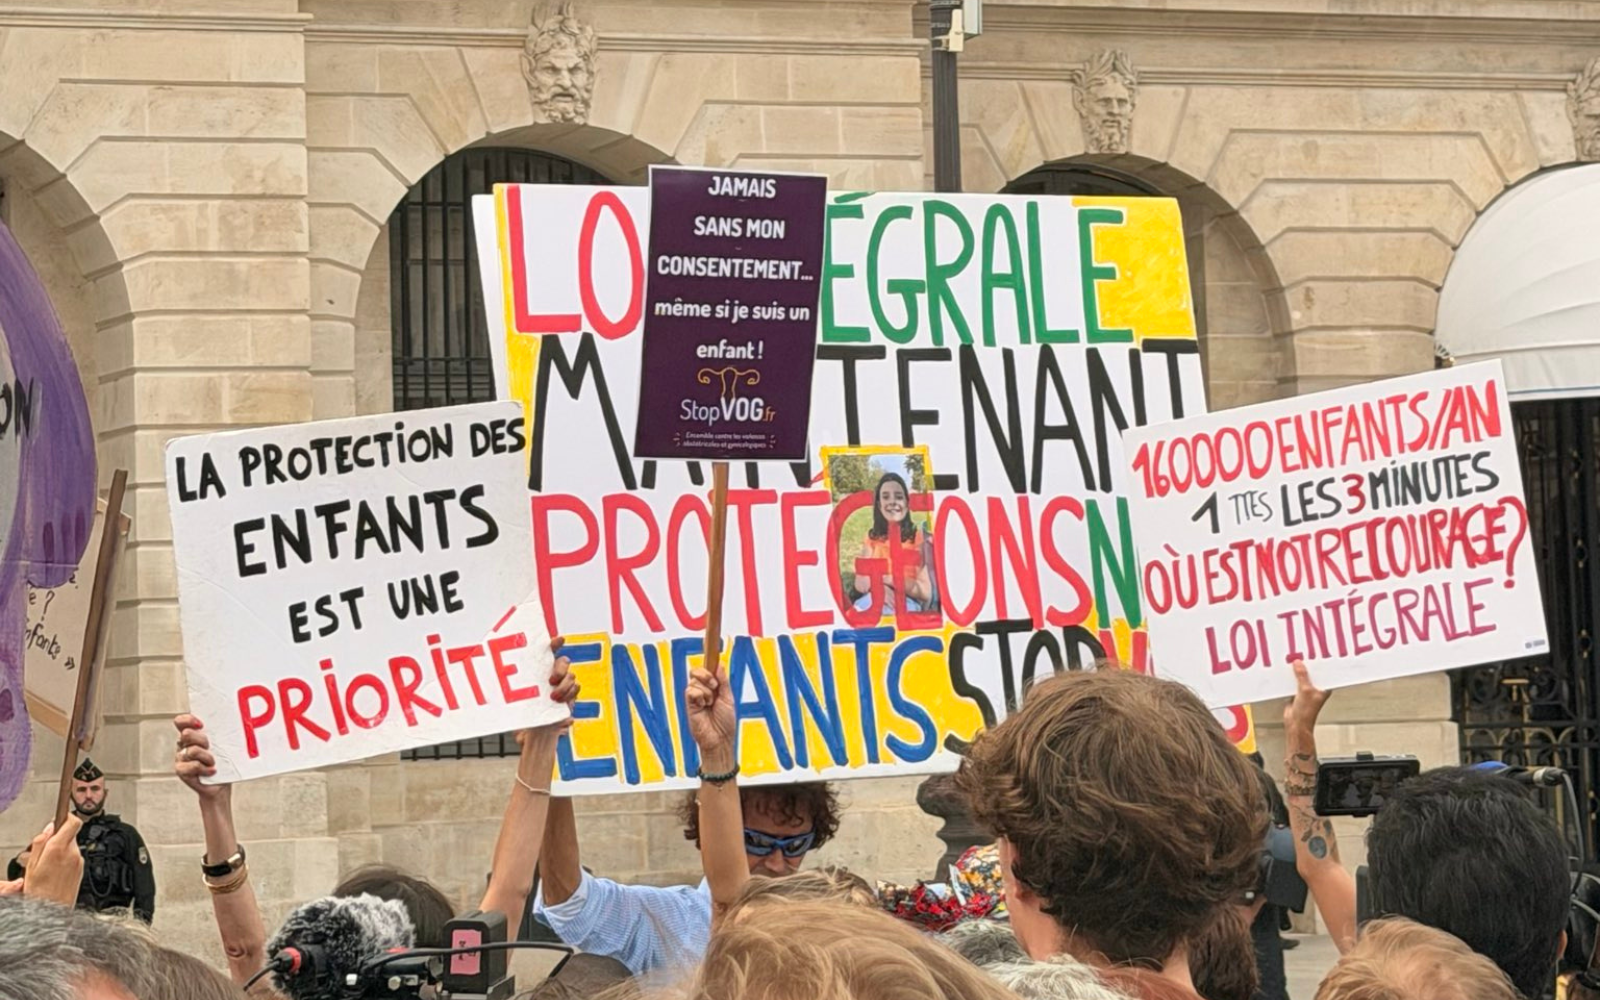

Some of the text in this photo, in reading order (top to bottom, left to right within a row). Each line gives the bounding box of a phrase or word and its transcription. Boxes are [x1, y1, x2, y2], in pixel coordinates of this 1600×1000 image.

[708, 176, 777, 199] JAMAIS
[694, 215, 786, 240] SANS MON
[507, 185, 1134, 347] LO ÉGRALE
[657, 254, 814, 282] CONSENTEMENT...
[654, 297, 810, 324] même si je suis un
[696, 339, 756, 360] enfant
[176, 452, 226, 503] LA
[470, 417, 527, 458] DES
[1131, 419, 1274, 499] 160000
[233, 484, 500, 577] ENFANTS
[1190, 491, 1220, 534] 1
[1279, 476, 1342, 527] LES
[1341, 474, 1367, 514] 3
[288, 570, 464, 644] EST UNE
[1204, 618, 1271, 676] LOI
[1276, 577, 1497, 664] INTÉGRALE
[555, 627, 943, 785] ENFANTS
